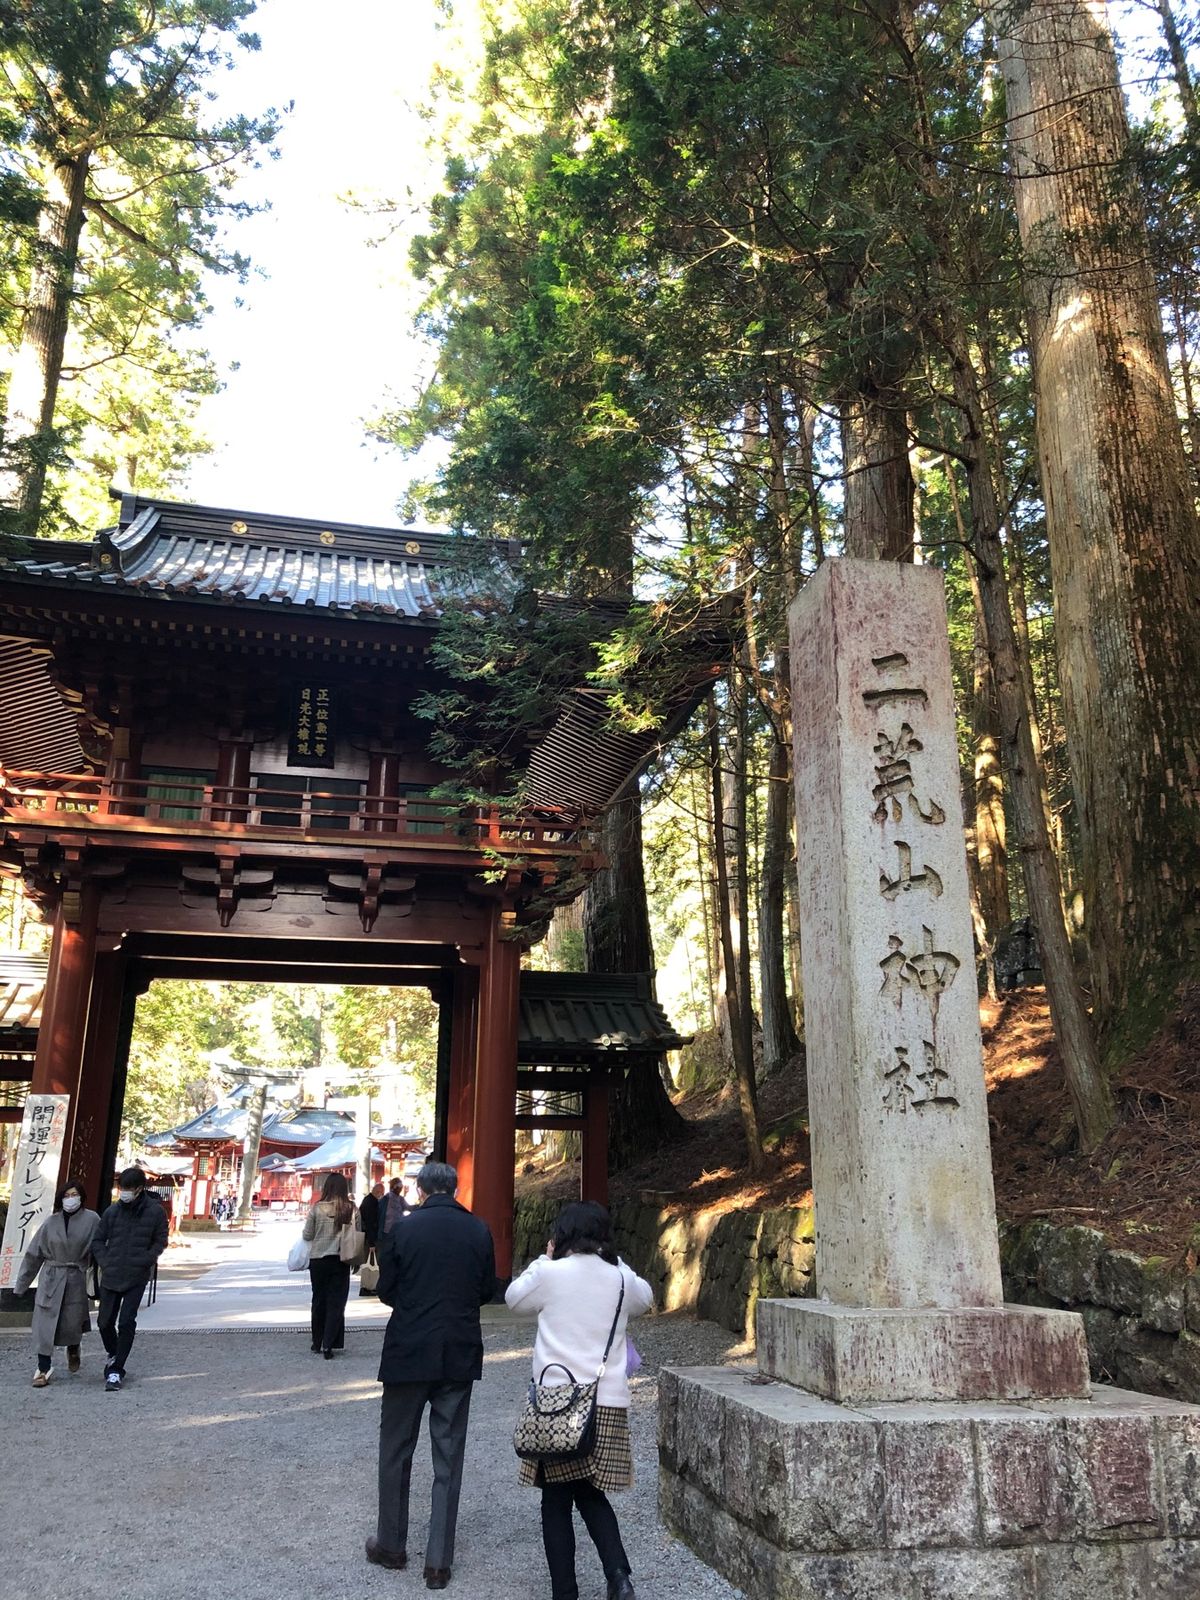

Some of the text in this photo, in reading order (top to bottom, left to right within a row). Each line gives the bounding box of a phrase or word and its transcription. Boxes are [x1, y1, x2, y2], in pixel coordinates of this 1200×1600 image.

[862, 652, 961, 1114] 二荒山神社
[18, 1105, 54, 1252] 開運カレンダー
